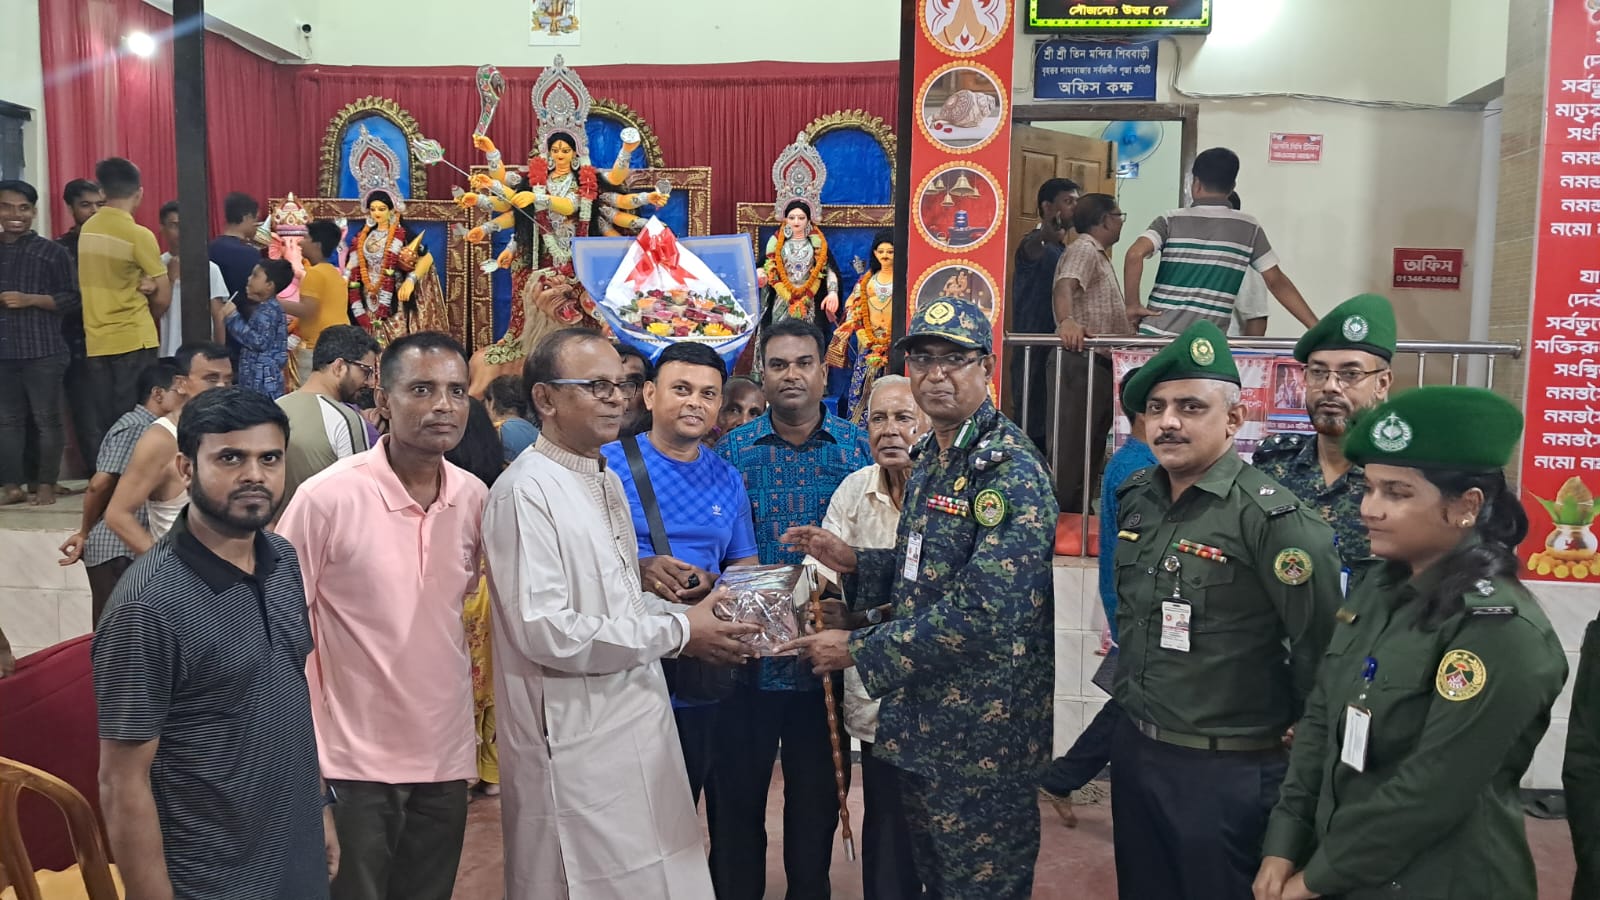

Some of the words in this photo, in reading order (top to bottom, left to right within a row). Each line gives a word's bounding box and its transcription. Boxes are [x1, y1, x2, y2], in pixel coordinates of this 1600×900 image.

[1044, 46, 1054, 60] শ্রী
[1056, 46, 1067, 60] শ্রী
[1070, 47, 1086, 59] তিন
[1089, 46, 1113, 59] মন্দির
[1116, 46, 1149, 60] শিববাড়ী
[1058, 78, 1100, 94] অফিস
[1105, 82, 1135, 94] কক্ষ
[1550, 222, 1592, 236] নমো
[1402, 254, 1453, 272] অফিস
[1534, 455, 1576, 469] নমো
